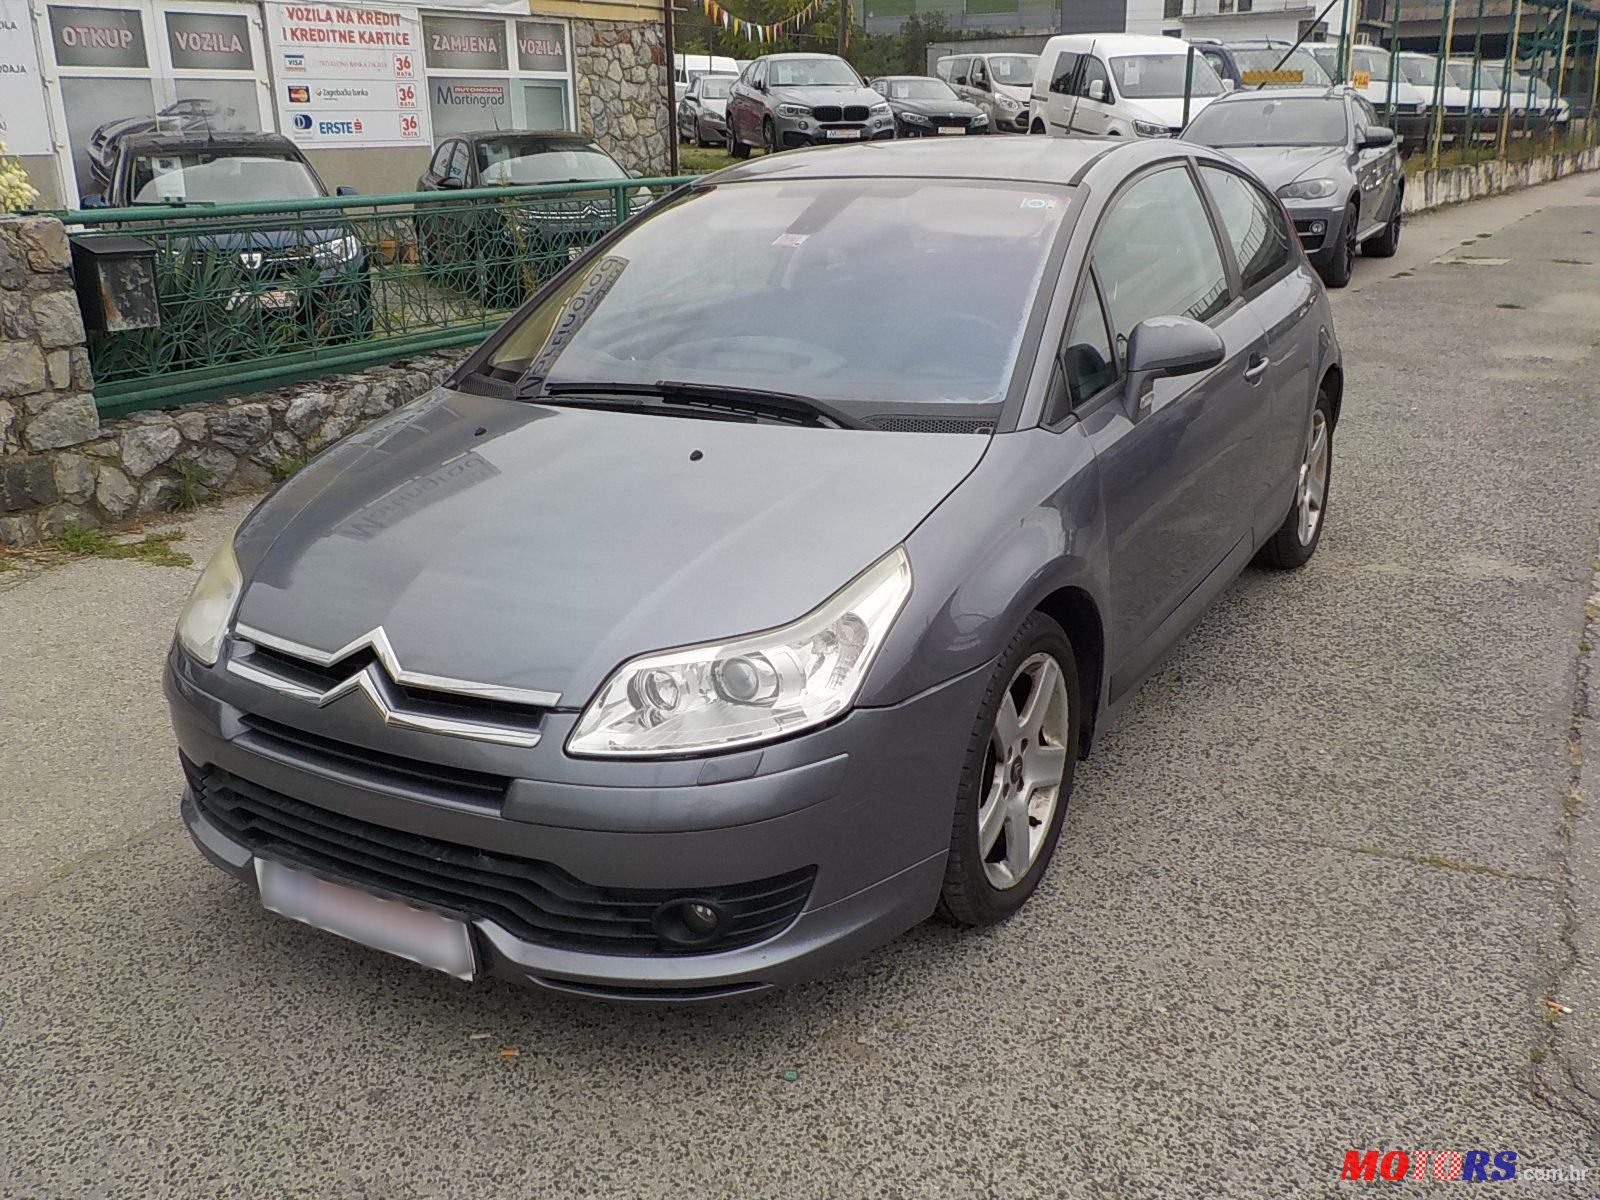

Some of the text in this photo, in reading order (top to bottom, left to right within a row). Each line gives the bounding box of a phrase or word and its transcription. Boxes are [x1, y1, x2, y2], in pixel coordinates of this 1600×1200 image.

[286, 6, 401, 27] VOZILA NA KREDIT
[62, 25, 134, 50] OTKUP
[175, 31, 244, 53] VOZILA
[282, 27, 410, 46] I KREDITNE KARTICE
[432, 34, 498, 53] ZAMJENA
[518, 38, 563, 56] VOZILA
[396, 56, 411, 71] 36
[352, 89, 369, 97] banka
[399, 86, 414, 101] 36
[437, 85, 505, 108] Martingrad
[319, 121, 354, 134] ERSTE
[402, 117, 417, 131] 36
